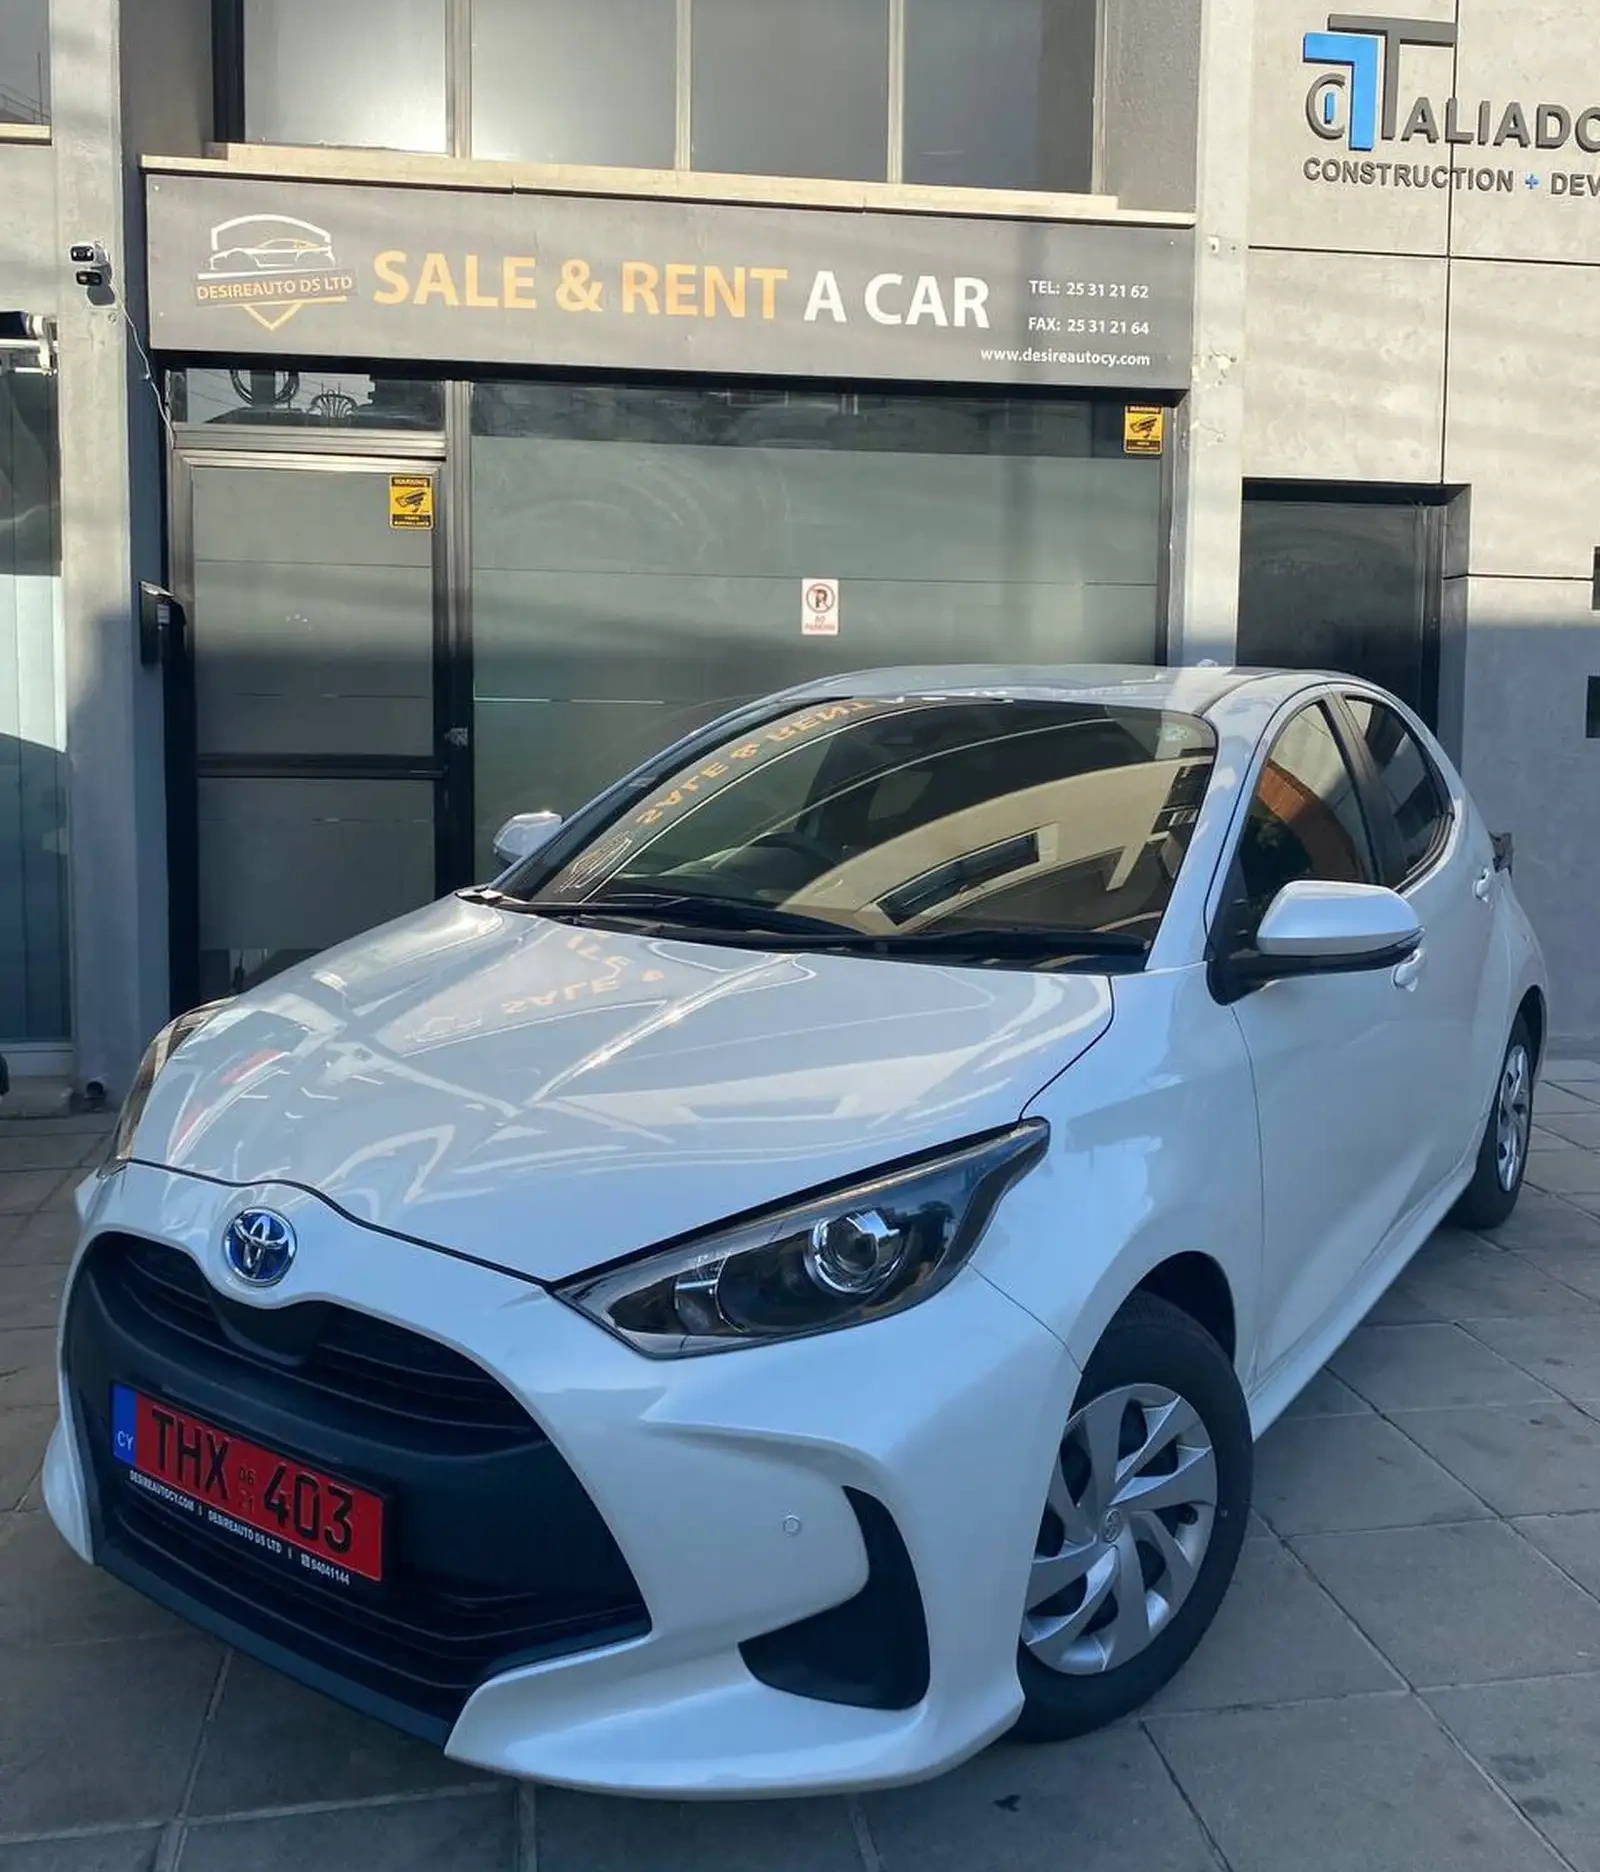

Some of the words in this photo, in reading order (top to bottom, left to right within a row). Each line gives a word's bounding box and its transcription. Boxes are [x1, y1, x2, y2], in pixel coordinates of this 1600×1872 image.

[1302, 157, 1514, 193] CONSTRUCTION
[196, 279, 296, 300] DESIREAUTO
[300, 277, 321, 292] DS
[324, 276, 353, 291] LTD
[373, 249, 538, 310] SALE
[555, 258, 604, 313] &
[621, 261, 789, 320] RENT
[803, 269, 848, 323] A
[864, 272, 991, 329] CAR
[1028, 280, 1061, 295] TEL:
[1066, 282, 1085, 296] 25
[1088, 283, 1105, 297] 31
[1109, 283, 1126, 299] 21
[1130, 285, 1149, 299] 62
[1028, 317, 1061, 332] FAX:
[1067, 318, 1085, 333] 25
[1088, 320, 1105, 333] 31
[1109, 320, 1127, 334] 21
[1131, 321, 1150, 335] 64
[980, 347, 1151, 368] www.desireautocy.com
[117, 1430, 134, 1450] CY
[152, 1404, 232, 1502] THX
[262, 1462, 355, 1555] 403
[208, 1510, 254, 1542] DESIREAUTO
[254, 1532, 266, 1547] DS
[267, 1538, 283, 1554] LTD
